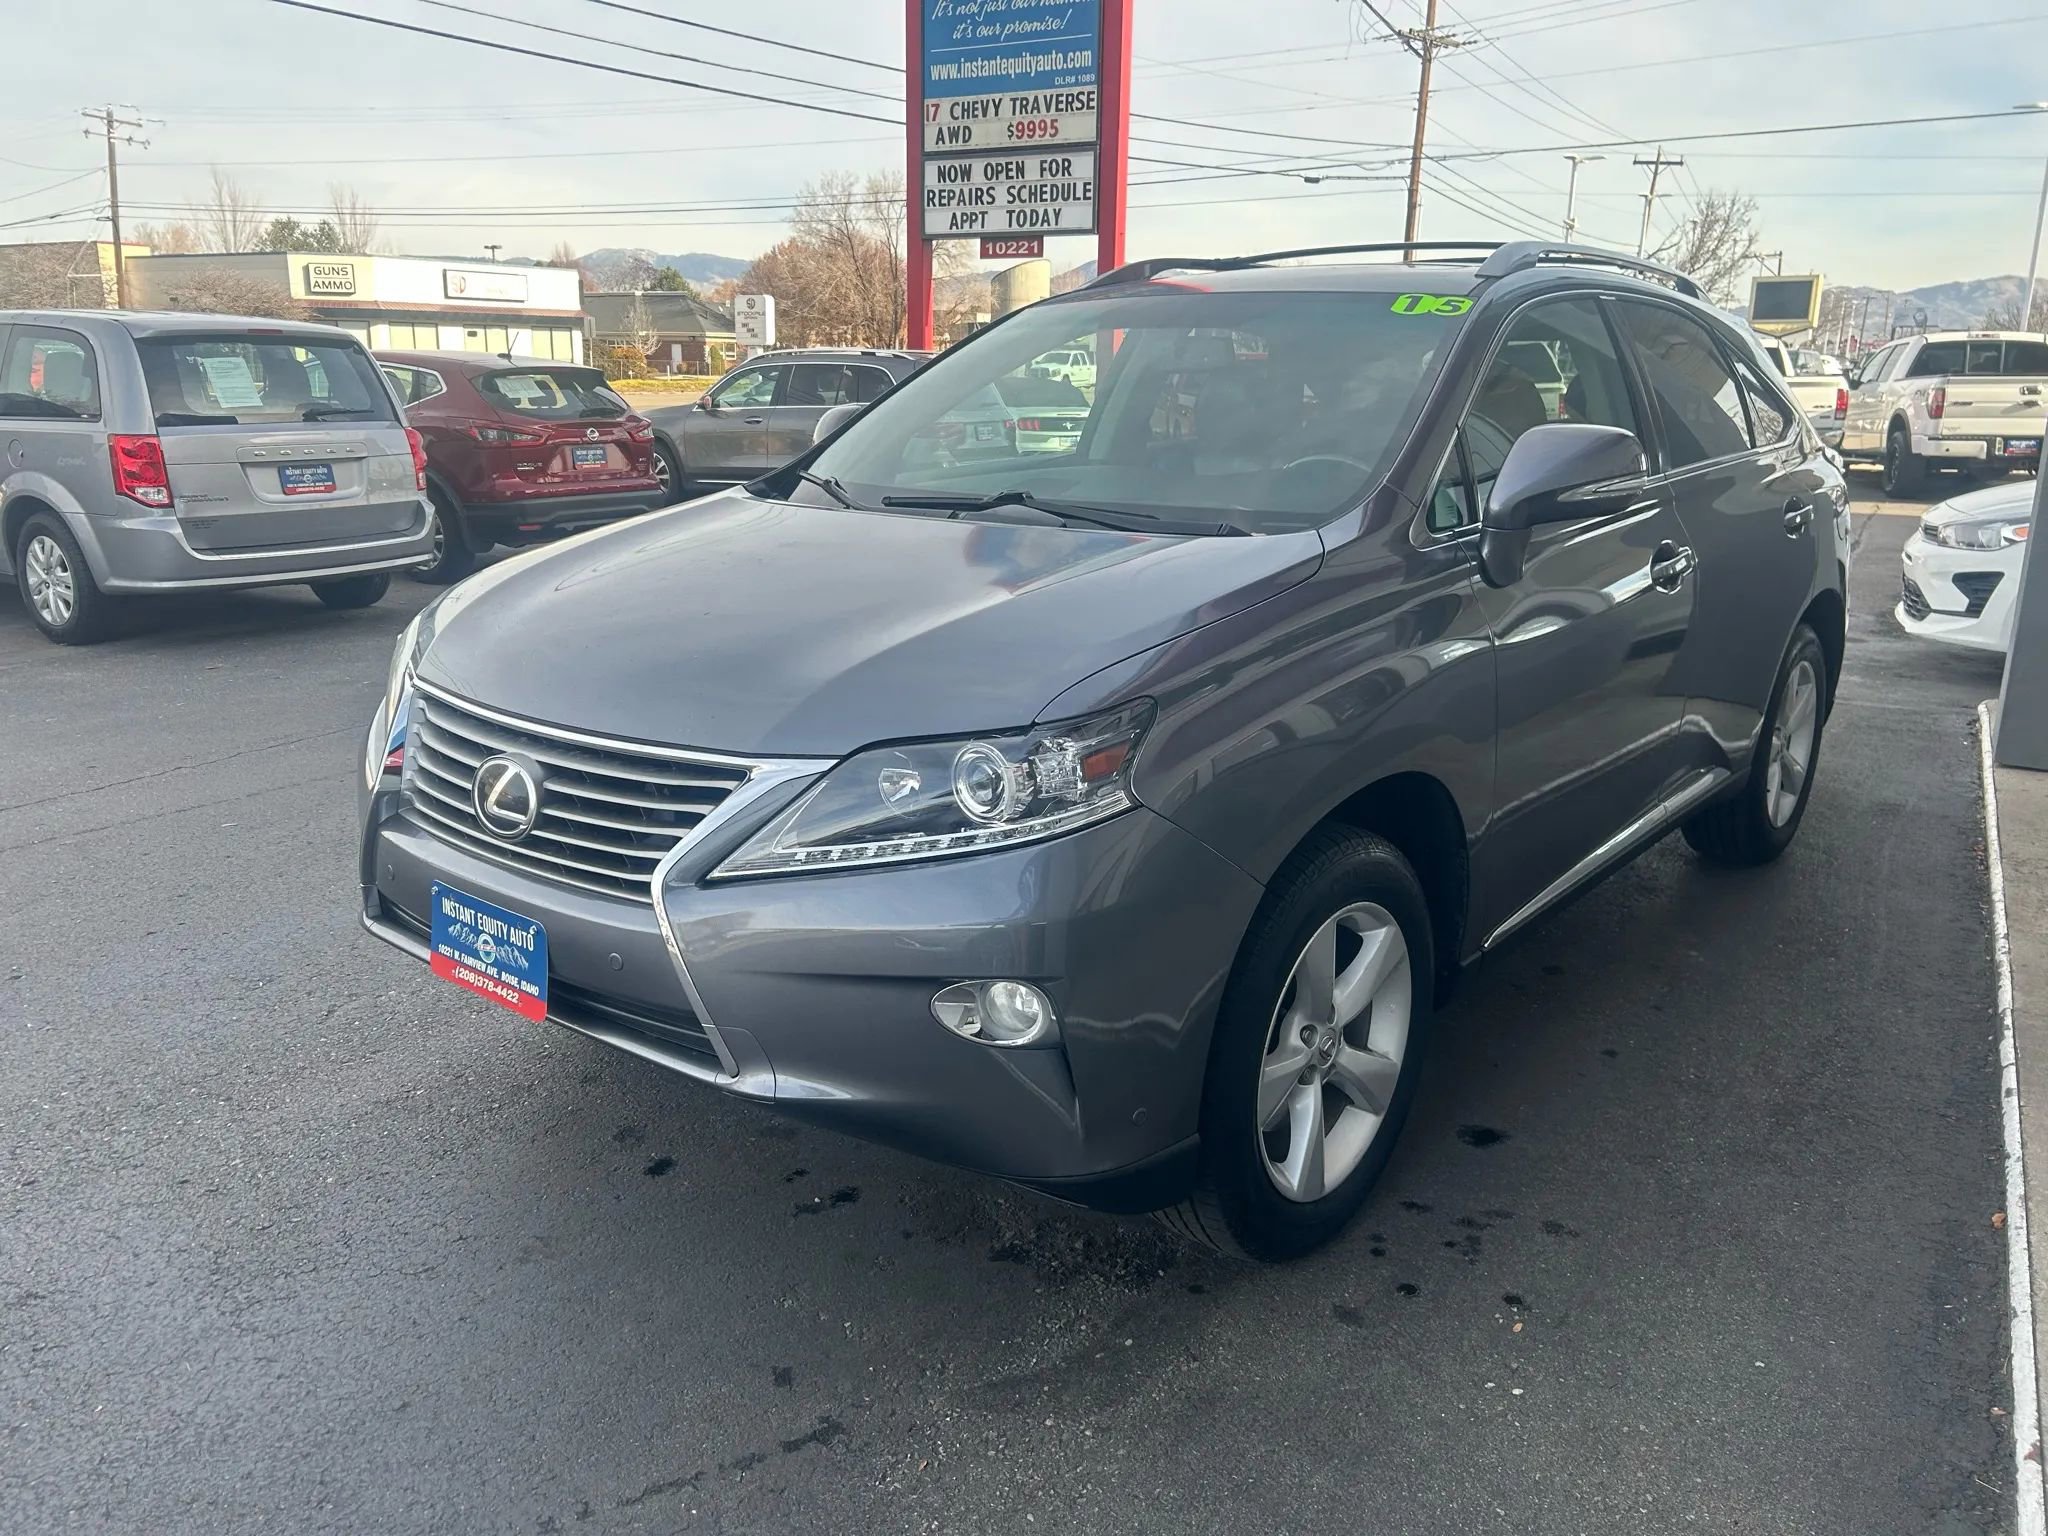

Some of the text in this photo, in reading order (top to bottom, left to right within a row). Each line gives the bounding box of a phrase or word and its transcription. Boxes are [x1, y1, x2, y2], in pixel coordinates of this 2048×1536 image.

[932, 0, 953, 20] It's
[956, 0, 981, 15] not
[975, 0, 1008, 21] just
[952, 9, 1073, 41] it's our promise!
[931, 50, 1092, 80] www.instantequityauto.com
[1055, 74, 1096, 86] DLR# 1089
[925, 90, 1096, 122] 17 CHEVY TRAVERSE
[935, 118, 1060, 145] AWD $9995
[937, 158, 1072, 183] NOW OPEN FOR
[926, 181, 1092, 207] REPAIRS SCHEDULE
[949, 208, 1062, 230] APPT TODAY
[985, 240, 1039, 255] 10221
[313, 265, 349, 276] GUNS
[312, 279, 353, 291] AMMO
[442, 897, 534, 952] INSTANT EQUITY AUTO
[460, 953, 487, 973] FAIRVIEW
[486, 963, 499, 979] AVE.
[501, 971, 520, 989] BOISE,
[520, 979, 540, 996] IDAHO
